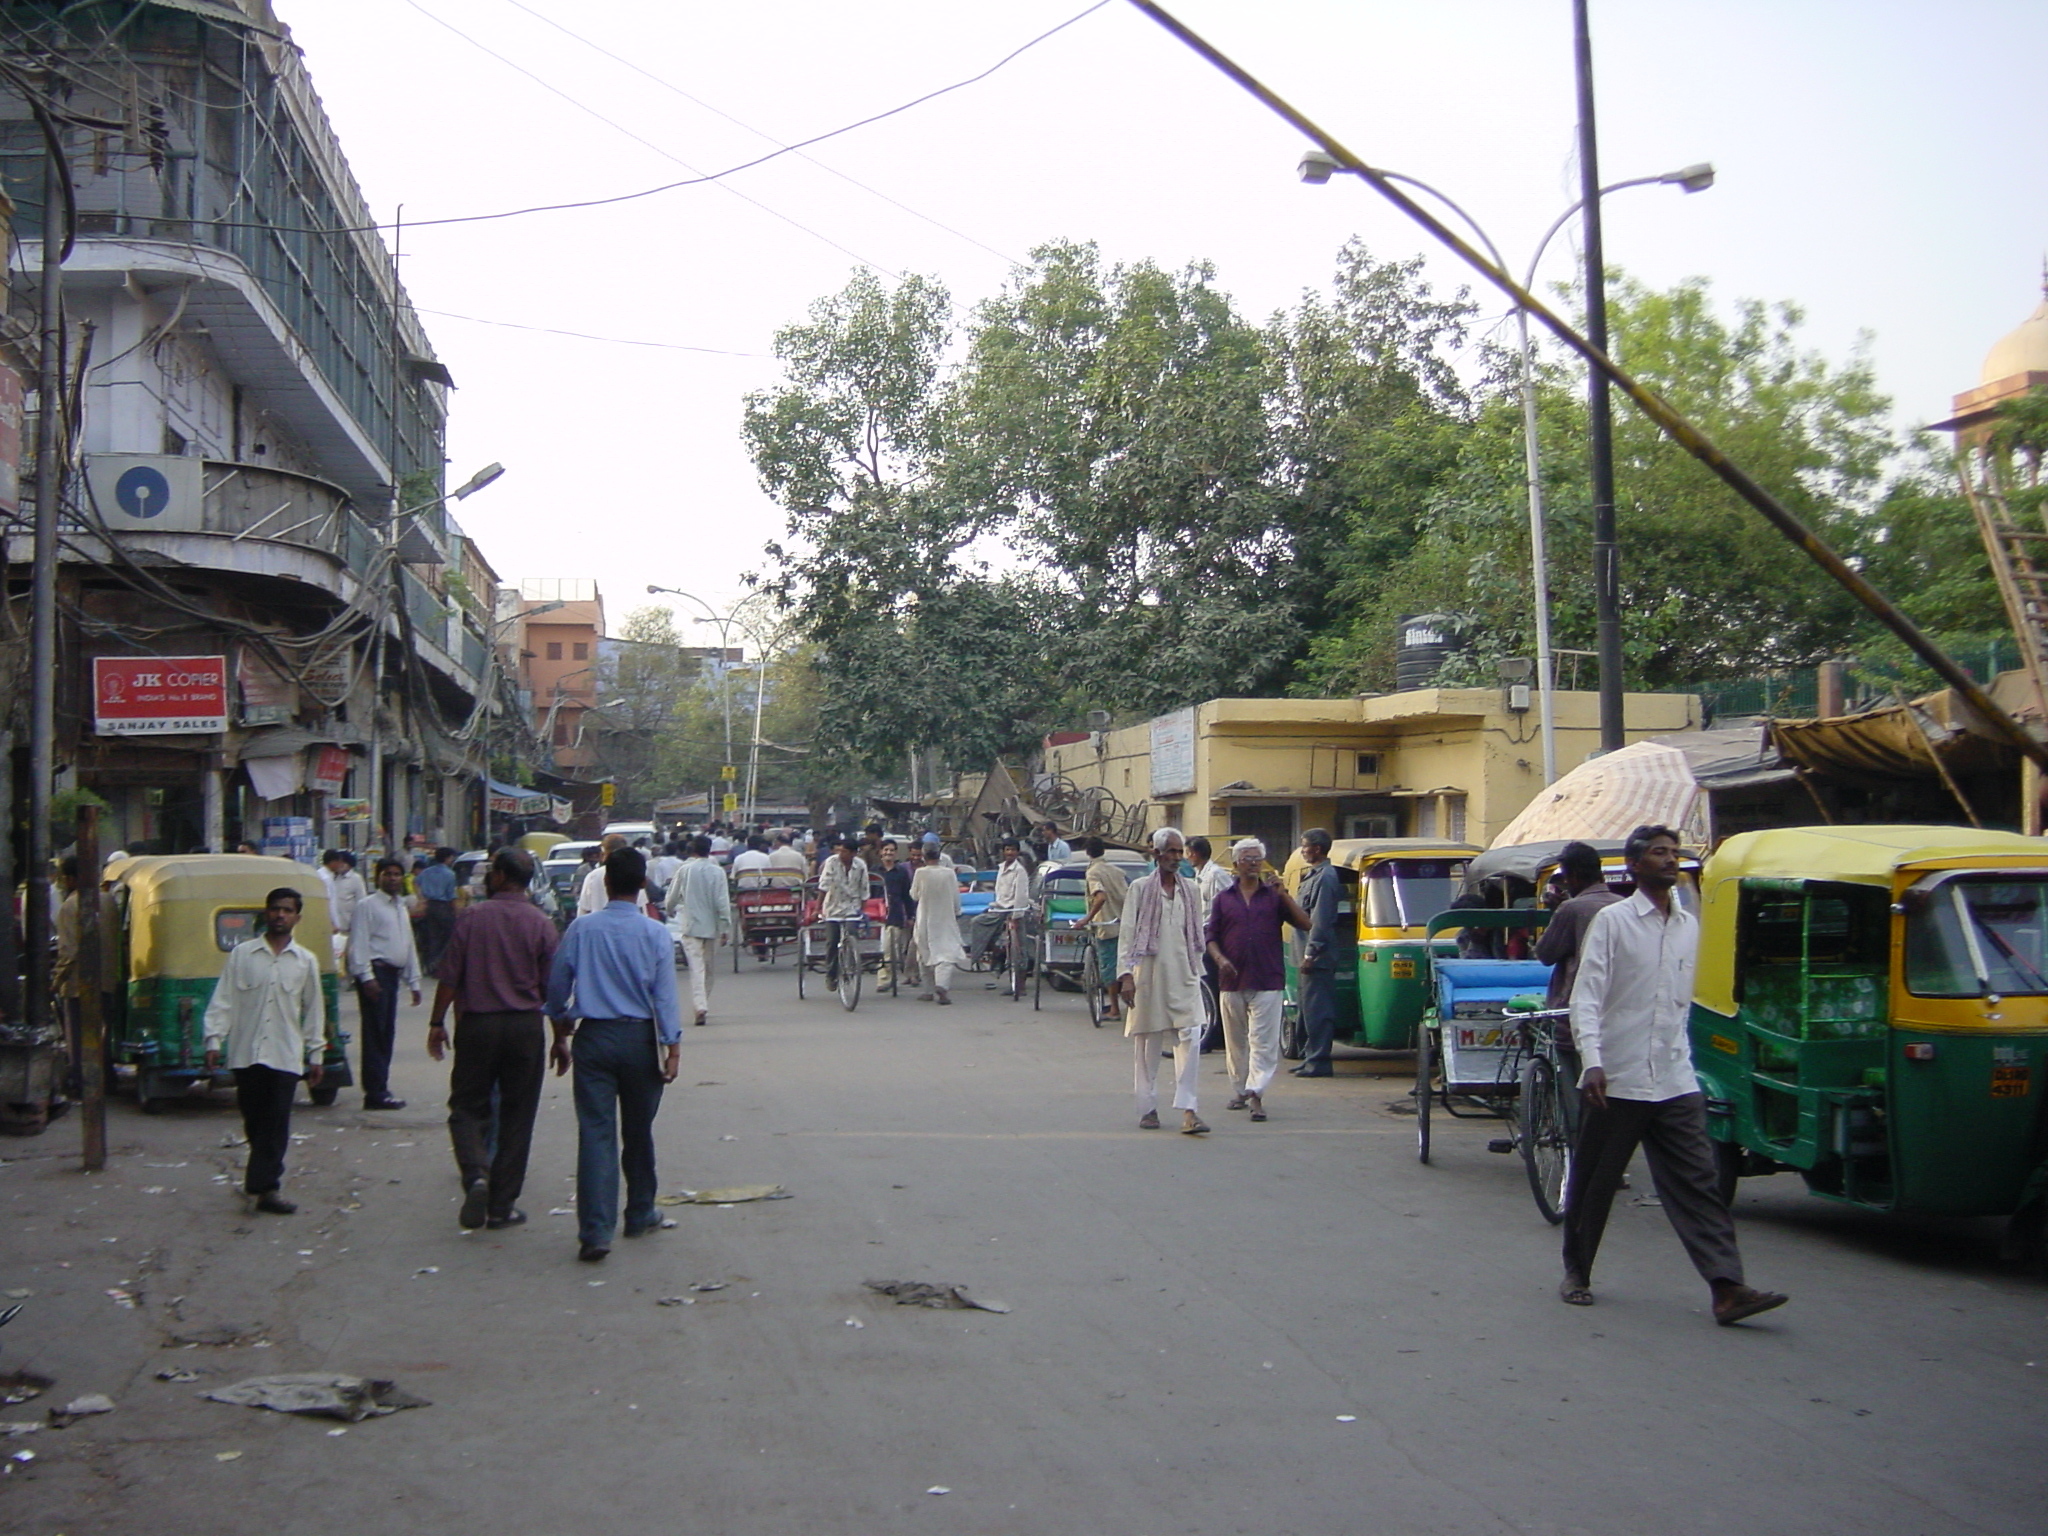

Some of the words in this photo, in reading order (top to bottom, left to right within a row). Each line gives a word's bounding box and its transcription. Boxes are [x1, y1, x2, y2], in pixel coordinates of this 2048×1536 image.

[132, 674, 162, 687] JK
[167, 673, 219, 687] COPIER
[107, 720, 166, 731] SANJAY
[172, 720, 218, 729] SALES
